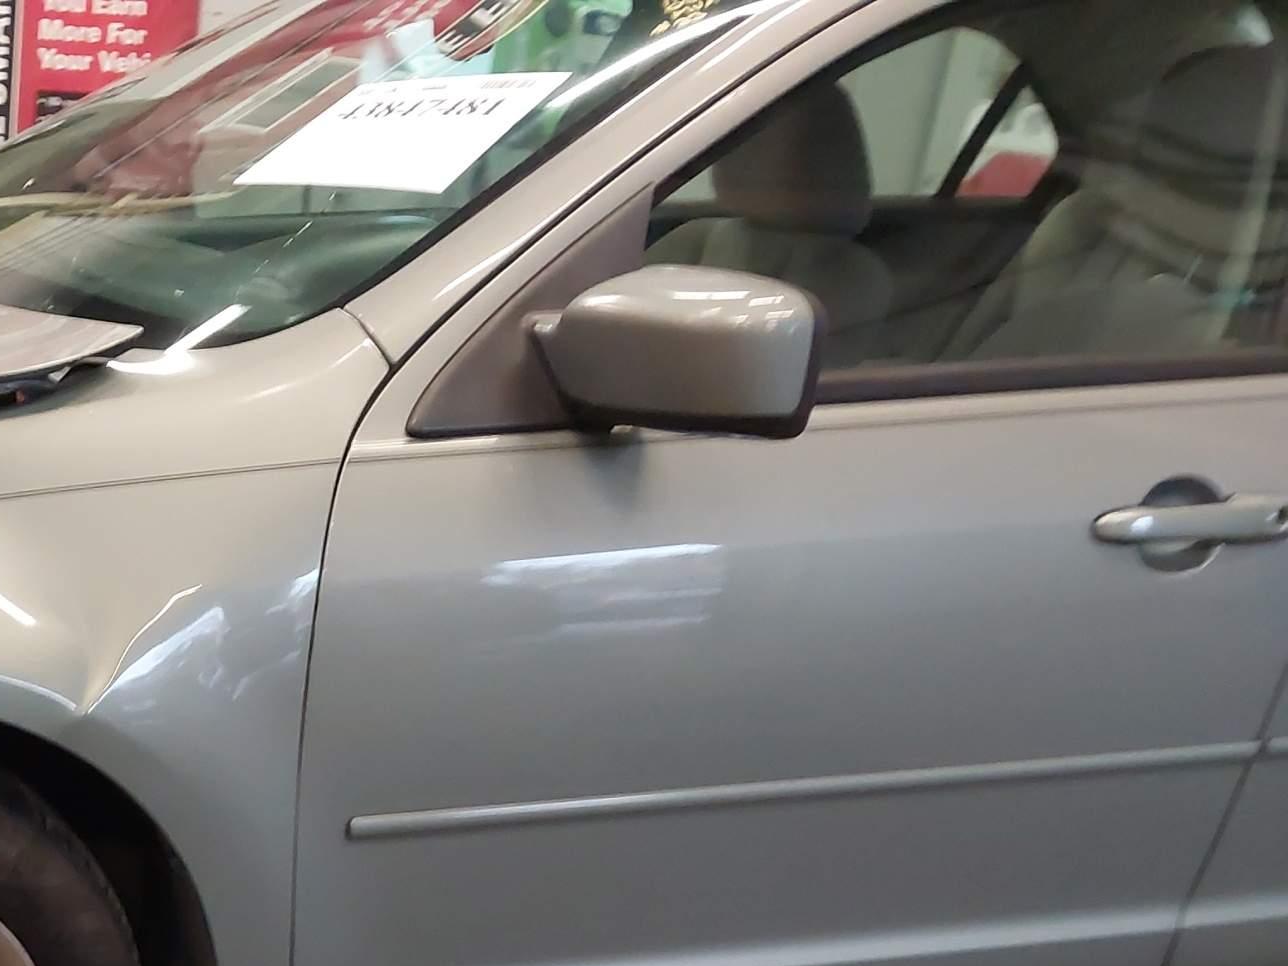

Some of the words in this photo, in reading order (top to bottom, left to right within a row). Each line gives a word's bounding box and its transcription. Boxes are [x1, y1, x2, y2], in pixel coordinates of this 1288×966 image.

[37, 18, 102, 42] More
[105, 22, 149, 45] For
[37, 47, 93, 71] Your
[96, 50, 152, 73] Vehi
